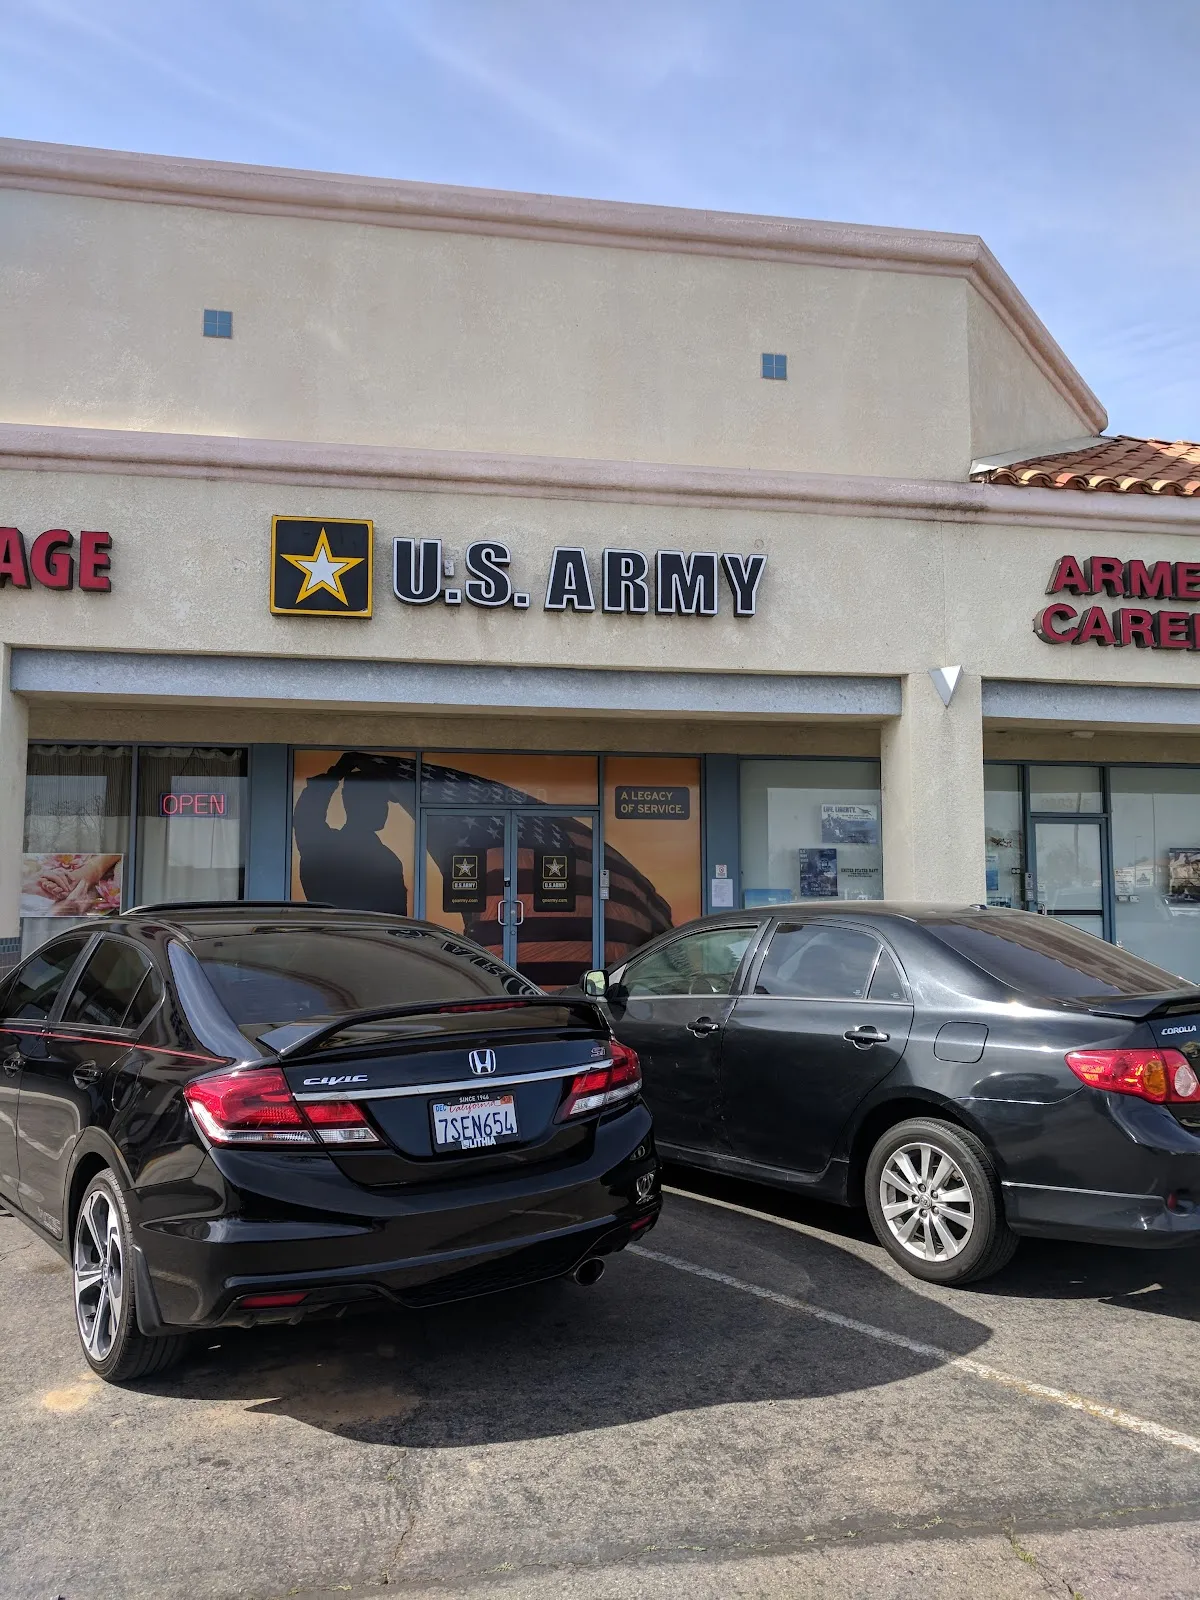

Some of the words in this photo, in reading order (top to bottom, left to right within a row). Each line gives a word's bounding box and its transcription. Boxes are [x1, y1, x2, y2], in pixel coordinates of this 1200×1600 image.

[0, 527, 112, 593] AGE
[393, 537, 530, 609] U.S.
[544, 546, 768, 617] ARMY
[1032, 603, 1200, 651] CARE
[621, 791, 629, 800] A
[631, 791, 673, 800] LEGACY
[163, 794, 225, 815] OPEN
[620, 804, 635, 813] OF
[637, 804, 685, 814] SERVICE.
[1160, 1025, 1197, 1035] COROLLA
[303, 1074, 369, 1086] CIVIC
[459, 1095, 476, 1103] SINCE
[436, 1104, 447, 1112] DEC
[438, 1111, 514, 1144] 7SEN654
[470, 1136, 497, 1148] LITHIA
